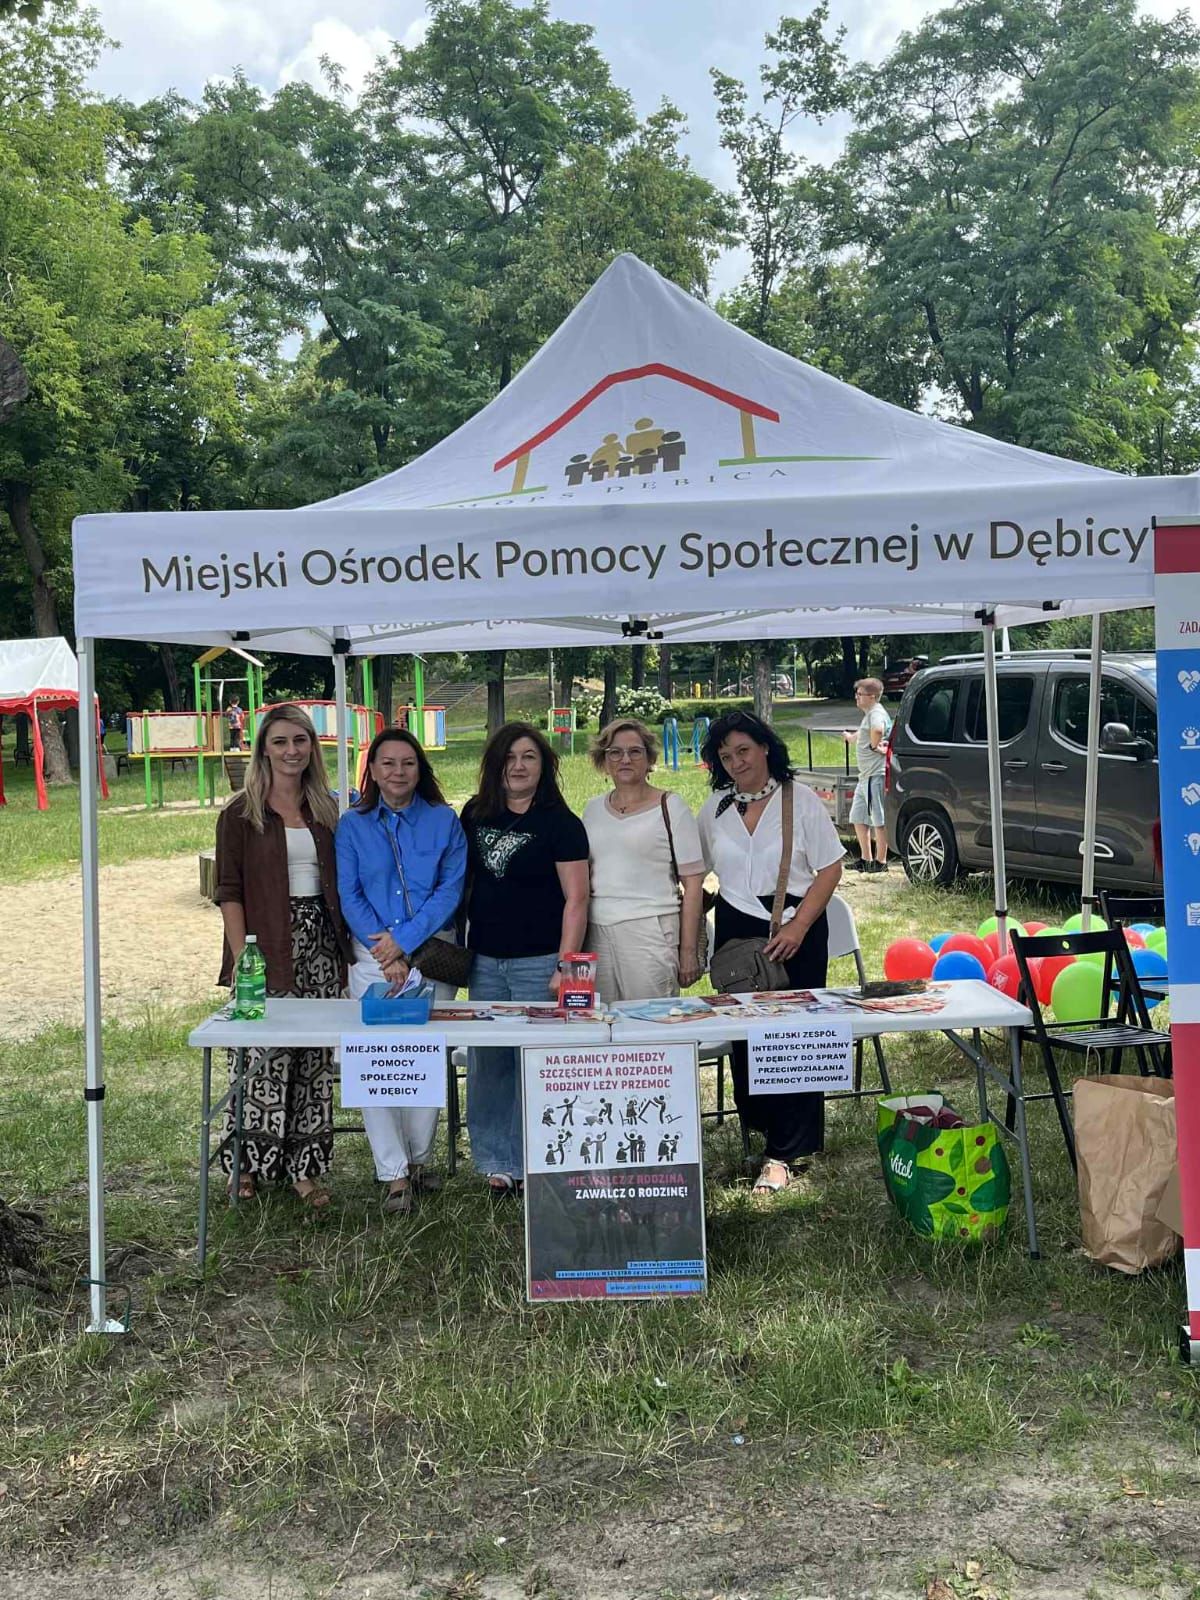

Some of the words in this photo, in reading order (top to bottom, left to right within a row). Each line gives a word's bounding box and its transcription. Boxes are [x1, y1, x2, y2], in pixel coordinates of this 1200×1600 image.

[142, 550, 288, 599] Miejski
[301, 543, 480, 587] Ośrodek
[495, 540, 666, 580] Pomocy
[680, 524, 919, 578] Społecznej
[934, 531, 974, 561] w
[990, 517, 1150, 566] Dębicy
[764, 1031, 800, 1040] MIEJSKI
[802, 1030, 837, 1038] ZESPÓŁ
[346, 1045, 388, 1053] MIEJSKI
[391, 1044, 440, 1053] OŚRODEK
[752, 1042, 850, 1052] INTERDYSCYPLINARNY
[371, 1059, 415, 1067] POMOCY
[546, 1055, 561, 1065] NA
[563, 1053, 609, 1065] GRANICY
[611, 1052, 666, 1064] POMIĘDZY
[765, 1055, 798, 1063] DĘBICY
[816, 1053, 847, 1061] SPRAW
[539, 1067, 602, 1079] SZCZĘŚCIEM
[605, 1067, 613, 1077] A
[615, 1065, 673, 1076] ROZPADEM
[758, 1064, 845, 1073] PRZECIWDZIAŁANIA
[360, 1073, 426, 1081] SPOŁECZNEJ
[754, 1076, 801, 1085] PRZEMOCY
[804, 1075, 849, 1083] DOMOWEJ
[545, 1081, 590, 1092] RODZINY
[621, 1078, 671, 1090] PRZEMOC
[368, 1087, 378, 1095] W
[380, 1087, 418, 1096] DĘBICY
[575, 1188, 626, 1199] ZAWALCZ
[628, 1188, 635, 1198] O
[638, 1186, 688, 1198] RODZINĘ!
